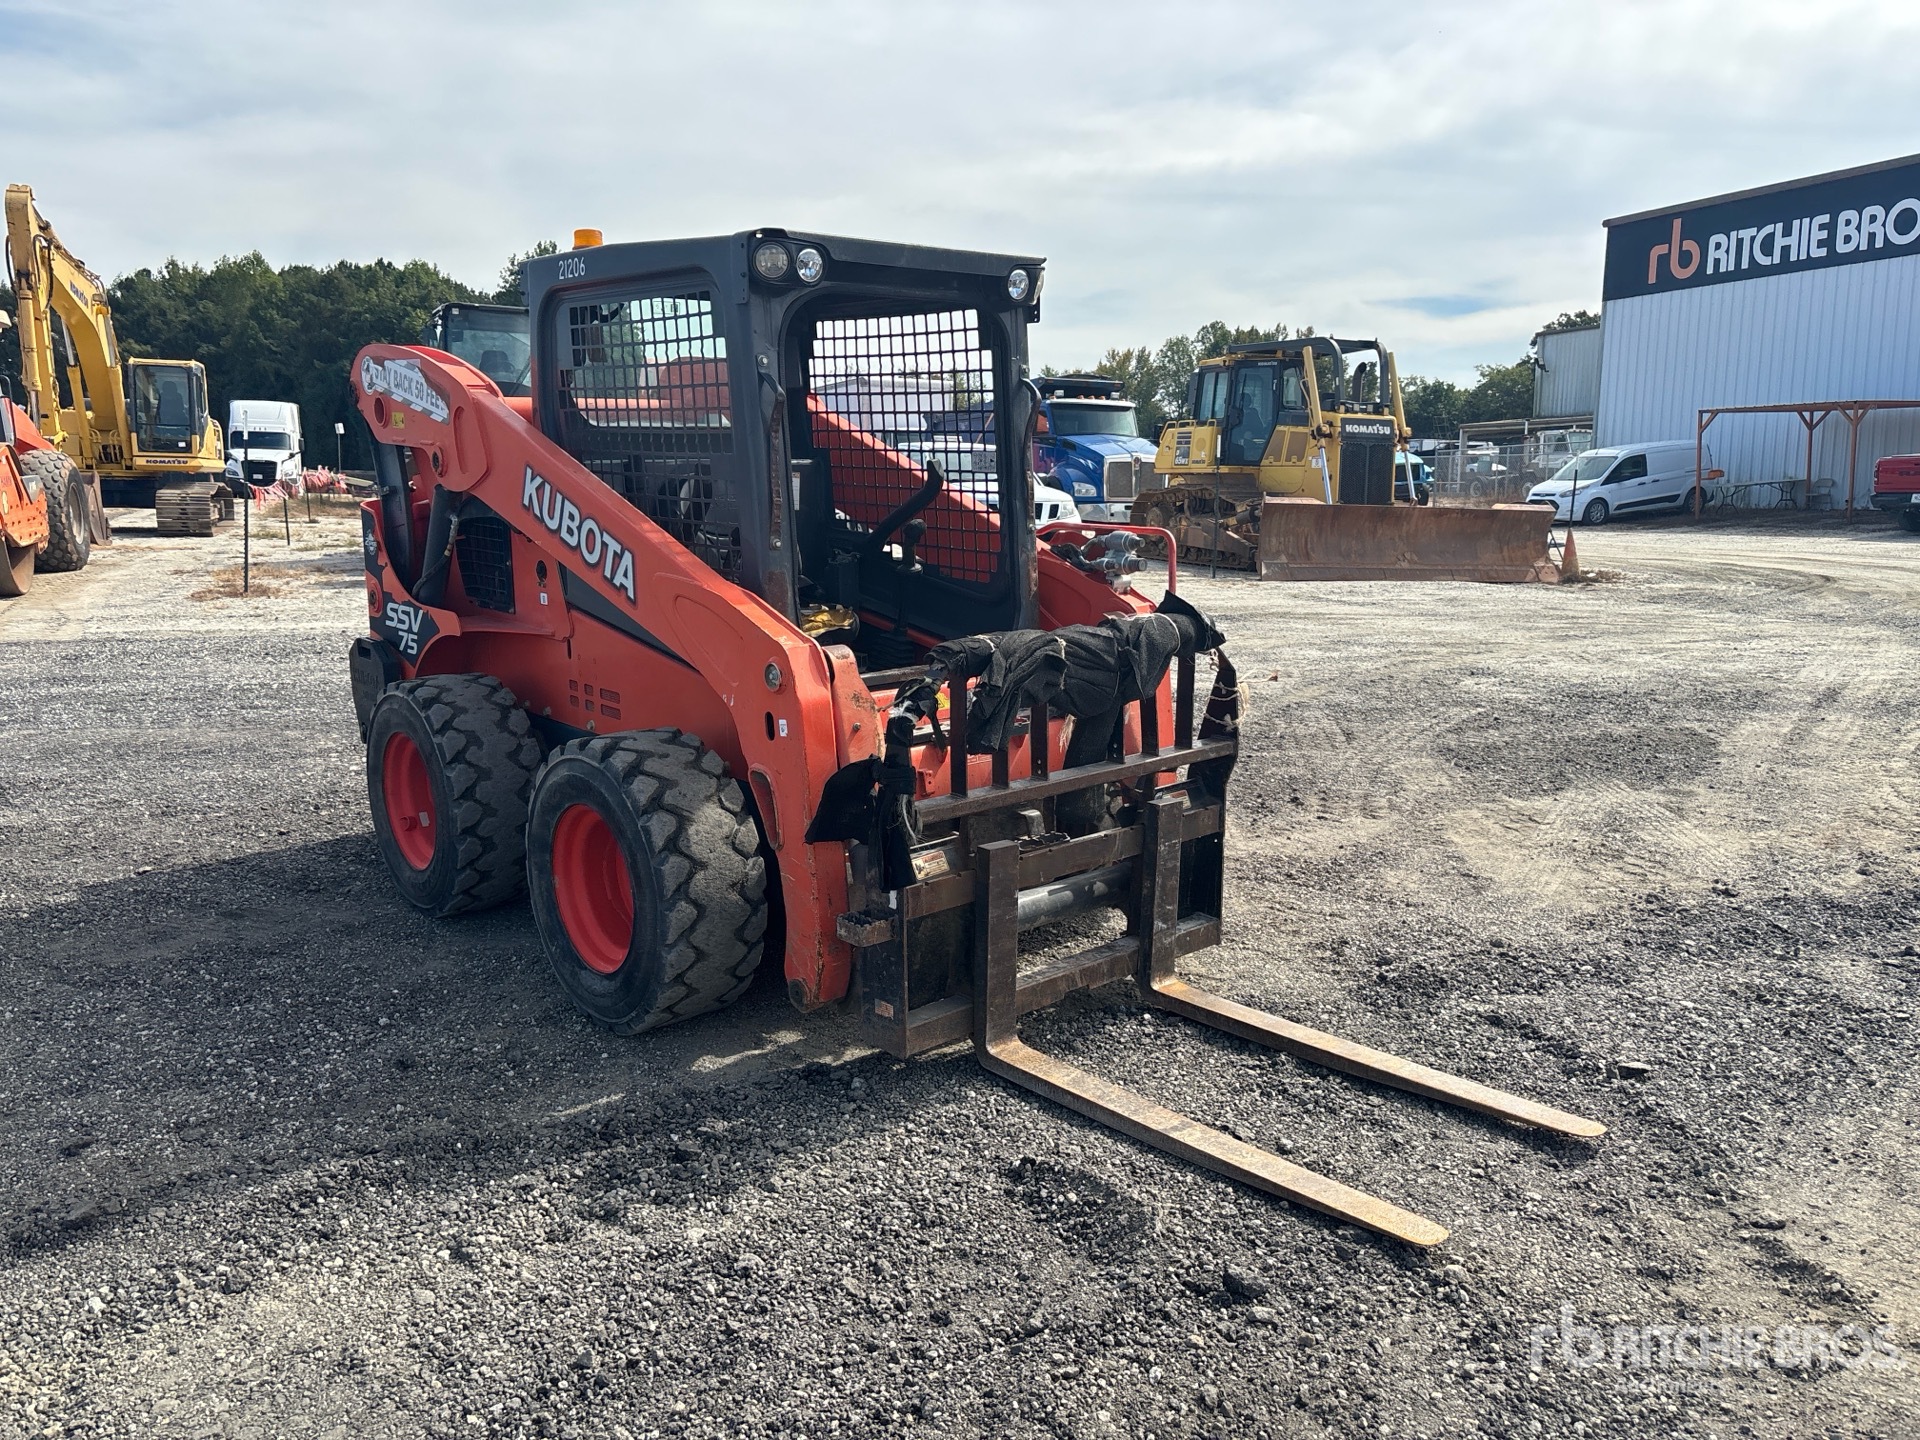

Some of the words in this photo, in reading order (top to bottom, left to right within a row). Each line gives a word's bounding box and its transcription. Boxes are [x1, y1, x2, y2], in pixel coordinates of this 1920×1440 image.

[1706, 212, 1831, 275] RITCHIE
[558, 256, 586, 280] 21206
[393, 368, 414, 397] BACK
[414, 380, 425, 402] 50
[1345, 423, 1391, 435] KOMATSU
[145, 458, 189, 466] KOMATSU
[522, 465, 636, 602] KUBOTA
[385, 601, 424, 633] SSV
[397, 631, 418, 655] 75
